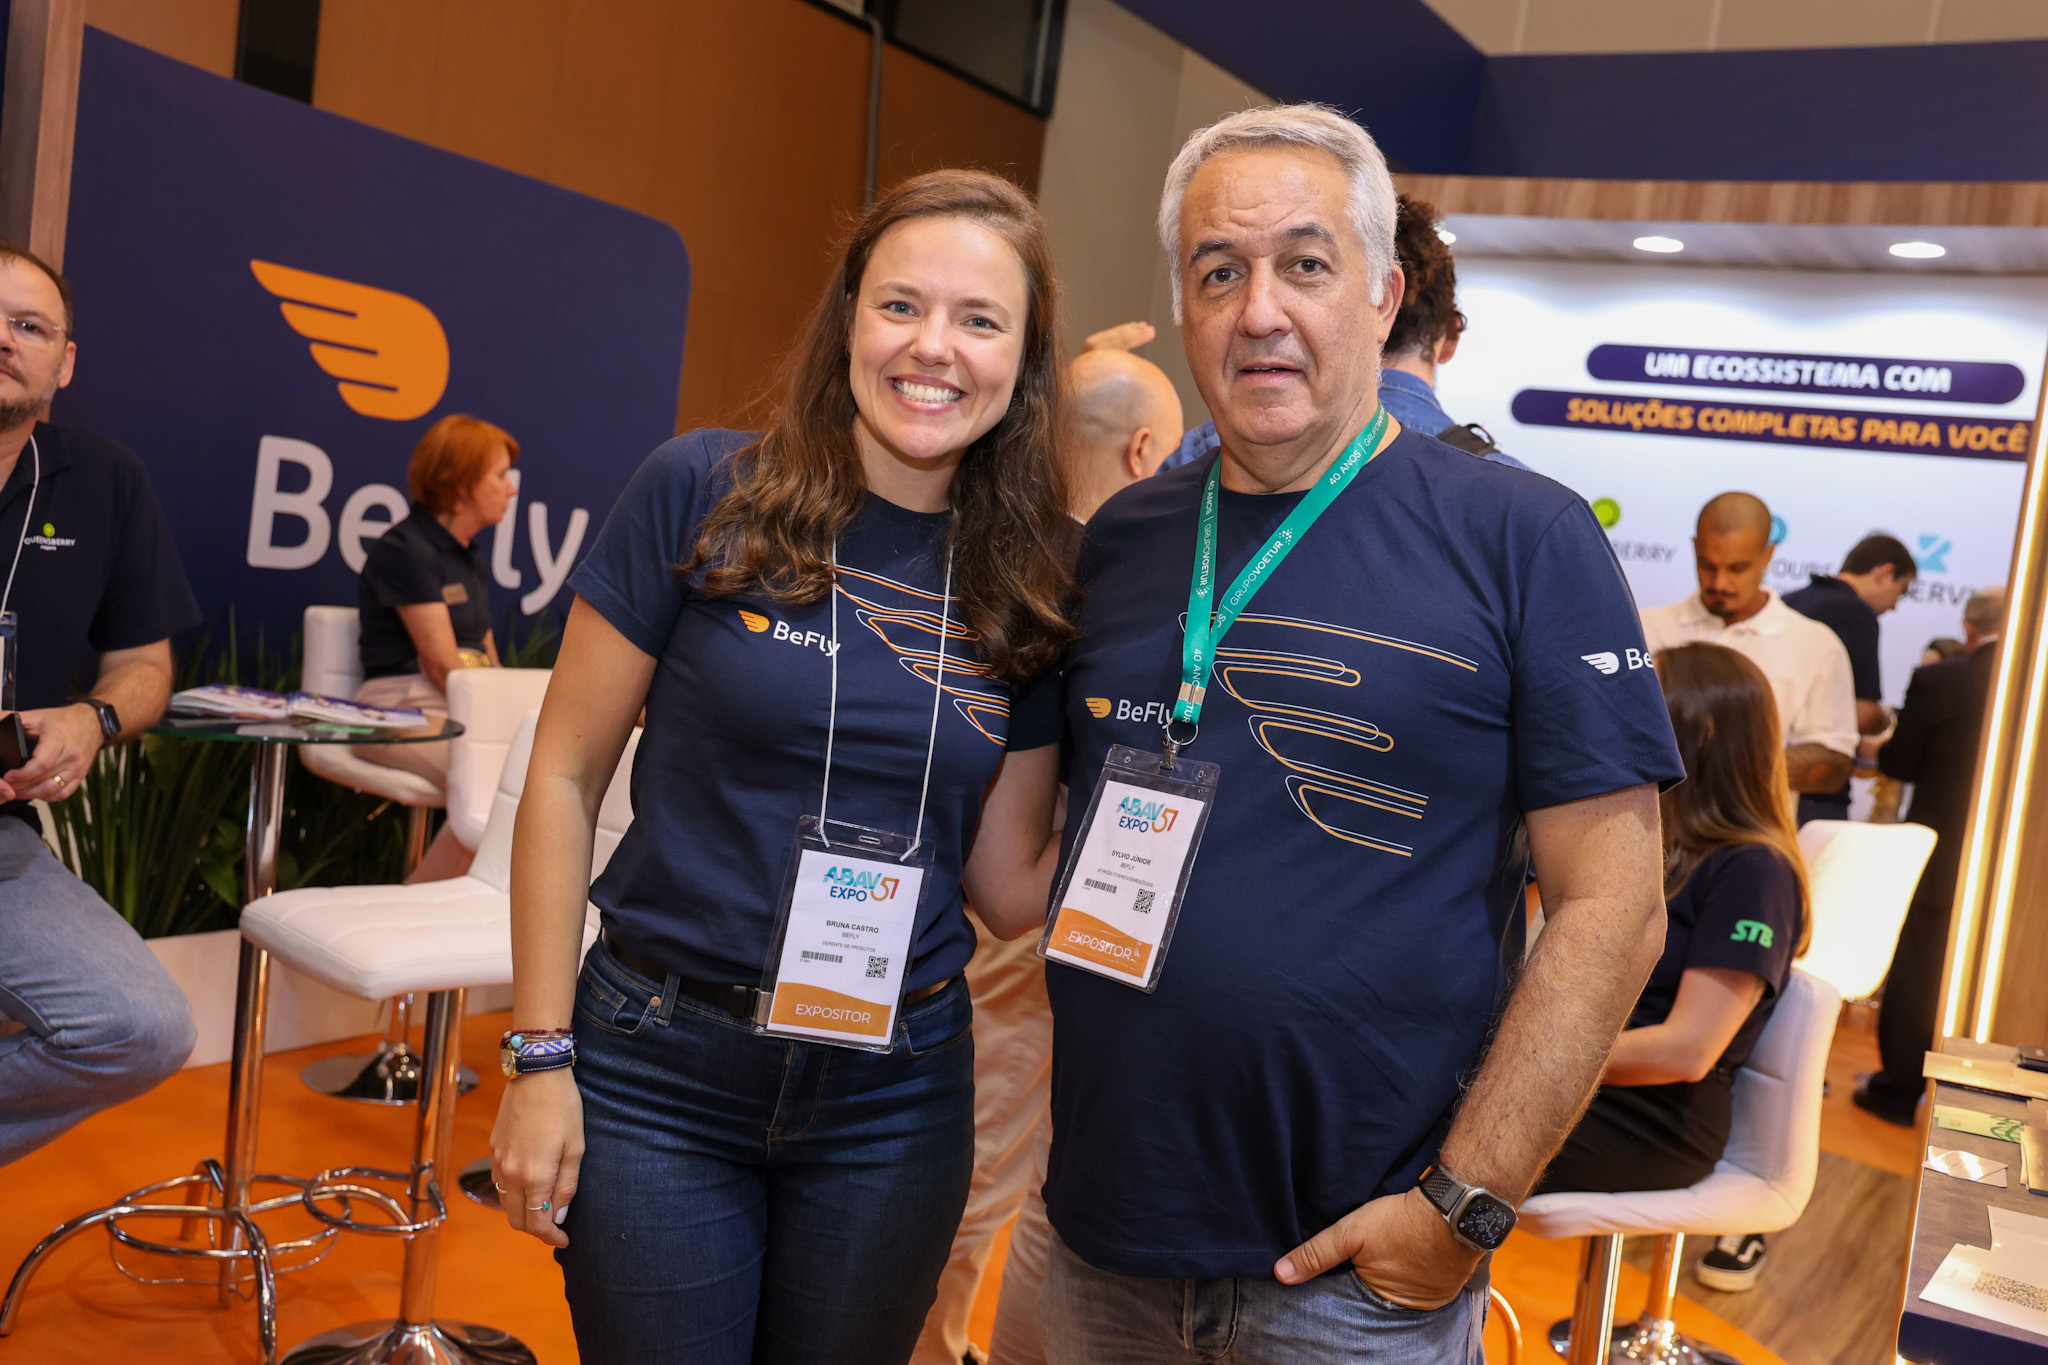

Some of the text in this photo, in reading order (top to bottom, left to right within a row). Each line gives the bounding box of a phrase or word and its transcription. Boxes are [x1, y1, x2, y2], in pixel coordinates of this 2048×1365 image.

[1644, 351, 1953, 394] UM ECOSSISTEMA COM
[1565, 396, 2029, 453] SOLUÇÕES COMPLETAS PARA VOCÊ
[1329, 472, 1341, 485] 40
[1340, 449, 1362, 474] ANOS
[1205, 492, 1213, 515] ANOS
[247, 434, 590, 616] Bely
[1200, 523, 1212, 586] GRUPOVOETUR
[1230, 540, 1284, 606] GRUPOVOETUR
[773, 620, 841, 657] BeFly
[1192, 648, 1202, 687] 40 ANO
[1116, 699, 1173, 729] BeFly
[1116, 796, 1179, 833] ABAV 57
[1118, 816, 1149, 833] EXPO
[1111, 849, 1151, 866] SYLVIO JÚNIOR
[1120, 862, 1135, 871] BEFLY
[822, 866, 900, 902] ABAV 57
[830, 886, 867, 902] EXPO
[826, 920, 879, 934] BRUNA CASTRO
[842, 932, 860, 940] BEFLY
[1731, 919, 1774, 948] STB
[822, 940, 843, 948] GERENTE
[1068, 930, 1132, 960] EXPOSITOR
[795, 1003, 871, 1023] EXPOSITOR
